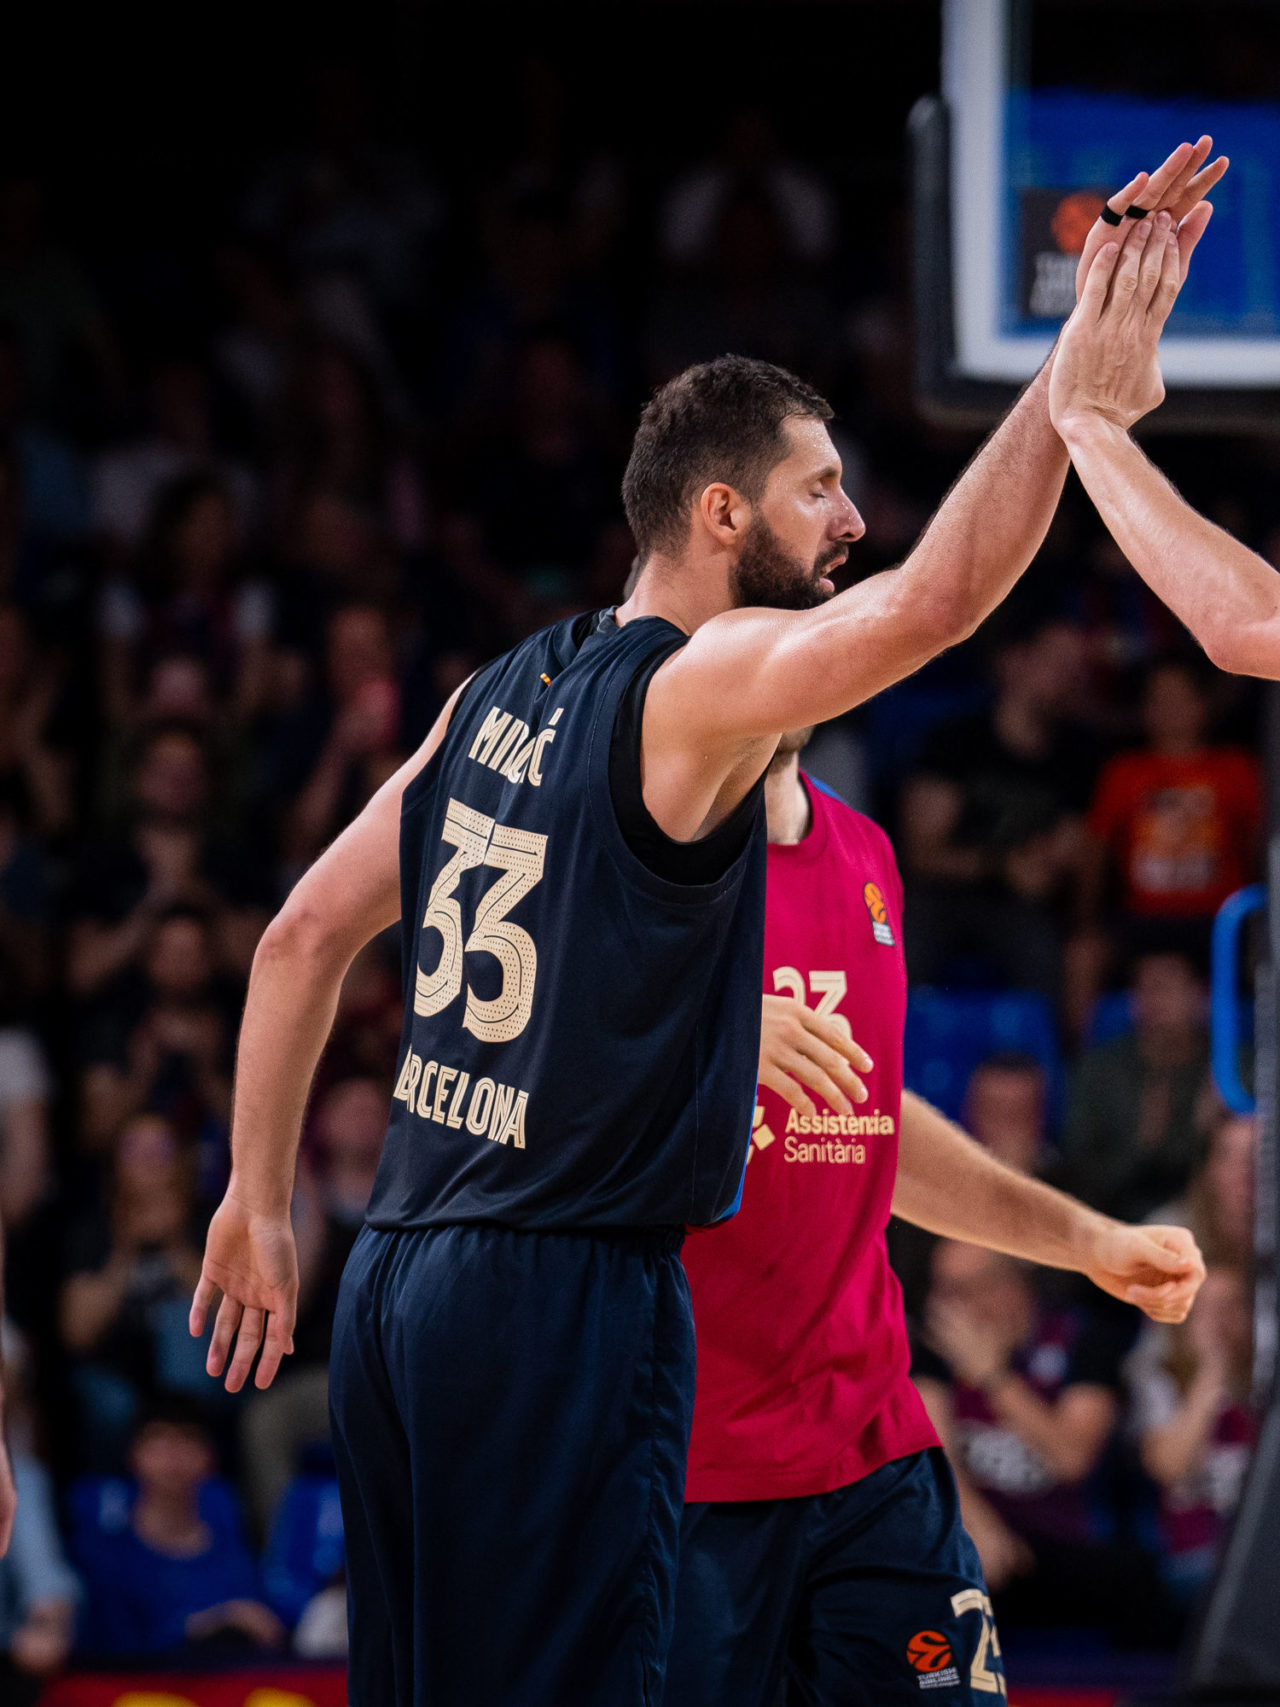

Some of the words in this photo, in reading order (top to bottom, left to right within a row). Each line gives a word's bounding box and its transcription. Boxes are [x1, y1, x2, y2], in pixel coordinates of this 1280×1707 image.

[414, 798, 548, 1043] 33
[784, 1136, 866, 1164] Sanitària
[951, 1588, 1007, 1698] 2
